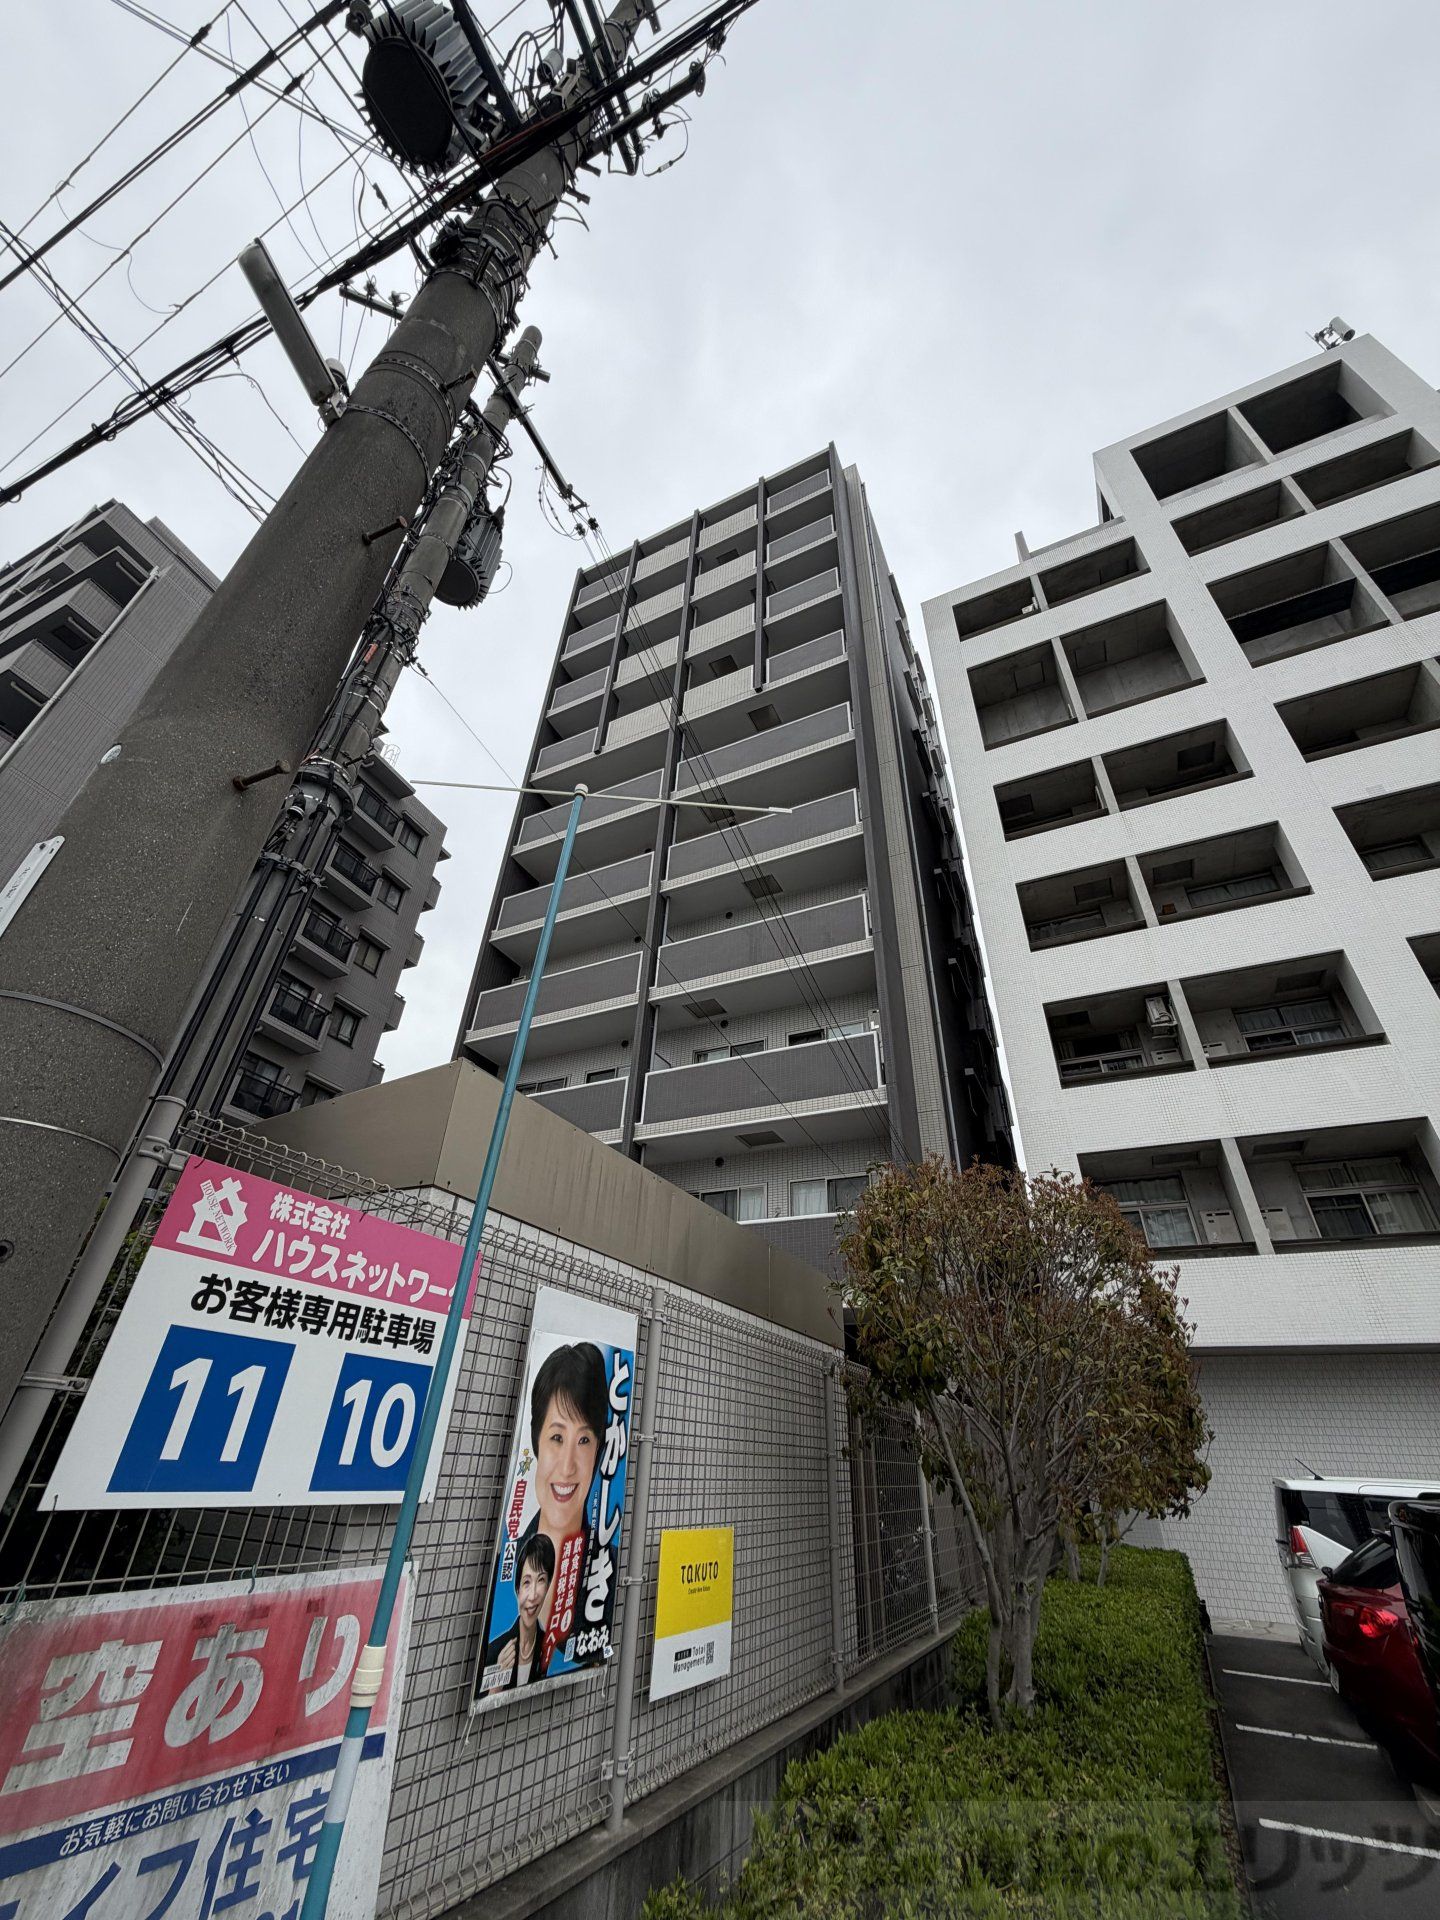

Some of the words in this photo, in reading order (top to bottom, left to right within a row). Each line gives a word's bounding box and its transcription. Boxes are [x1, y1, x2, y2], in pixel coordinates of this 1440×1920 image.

[213, 1210, 236, 1251] NETWORK
[269, 1191, 350, 1240] 株式会社
[251, 1229, 458, 1313] ハウスネットワー
[190, 1273, 437, 1355] お客様専用駐車場
[159, 1357, 267, 1463] 11
[338, 1379, 417, 1469] 10
[506, 1478, 528, 1539] 自民党
[584, 1351, 630, 1623] とかしき
[501, 1543, 516, 1581] 公認
[565, 1536, 583, 1609] 飲食料品
[576, 1624, 609, 1657] なおみ
[673, 1655, 705, 1674] Management
[693, 1645, 706, 1656] Total
[0, 1613, 361, 1797] 空あり
[58, 1763, 290, 1857] お気軽にお問い合わせ下さい
